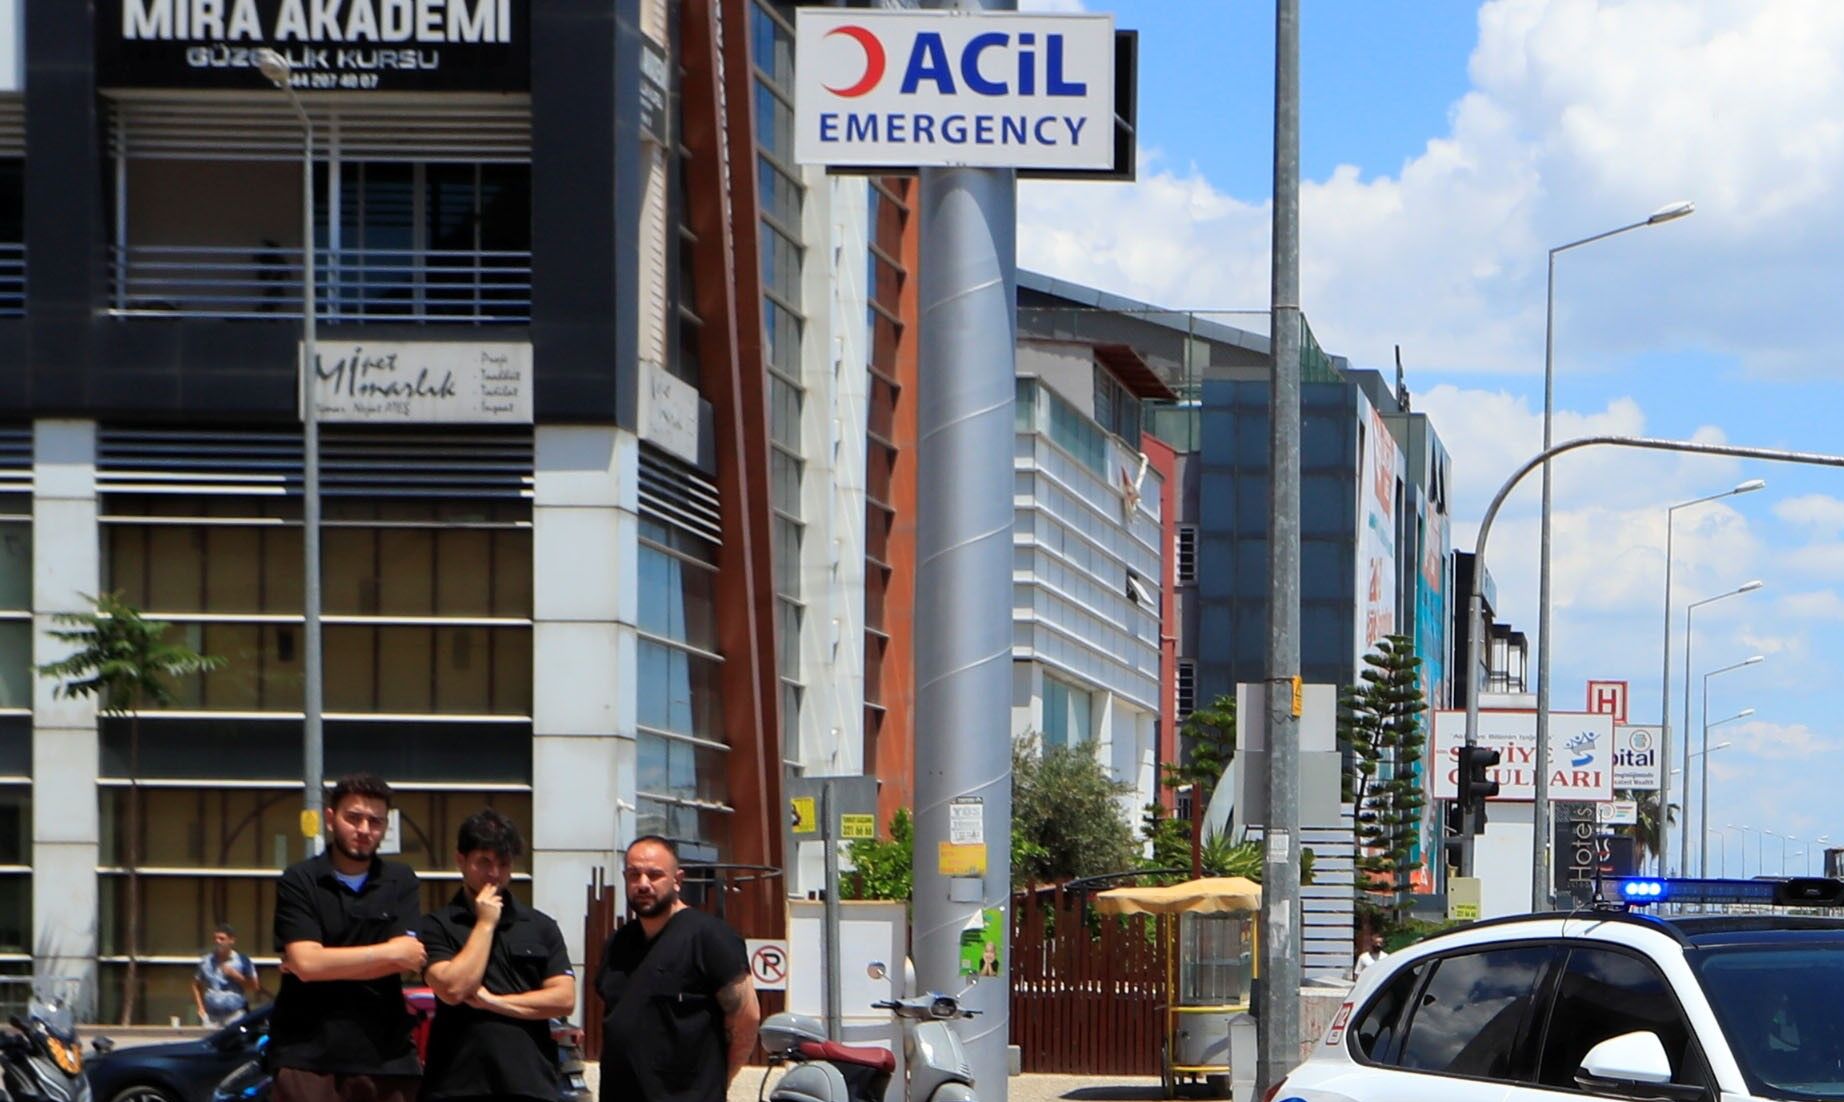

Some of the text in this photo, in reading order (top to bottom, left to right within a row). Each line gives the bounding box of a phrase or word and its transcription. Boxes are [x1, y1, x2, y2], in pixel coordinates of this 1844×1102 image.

[337, 48, 439, 70] KURSU
[819, 113, 1087, 146] EMERGENCY
[1569, 807, 1593, 882] Hotels
